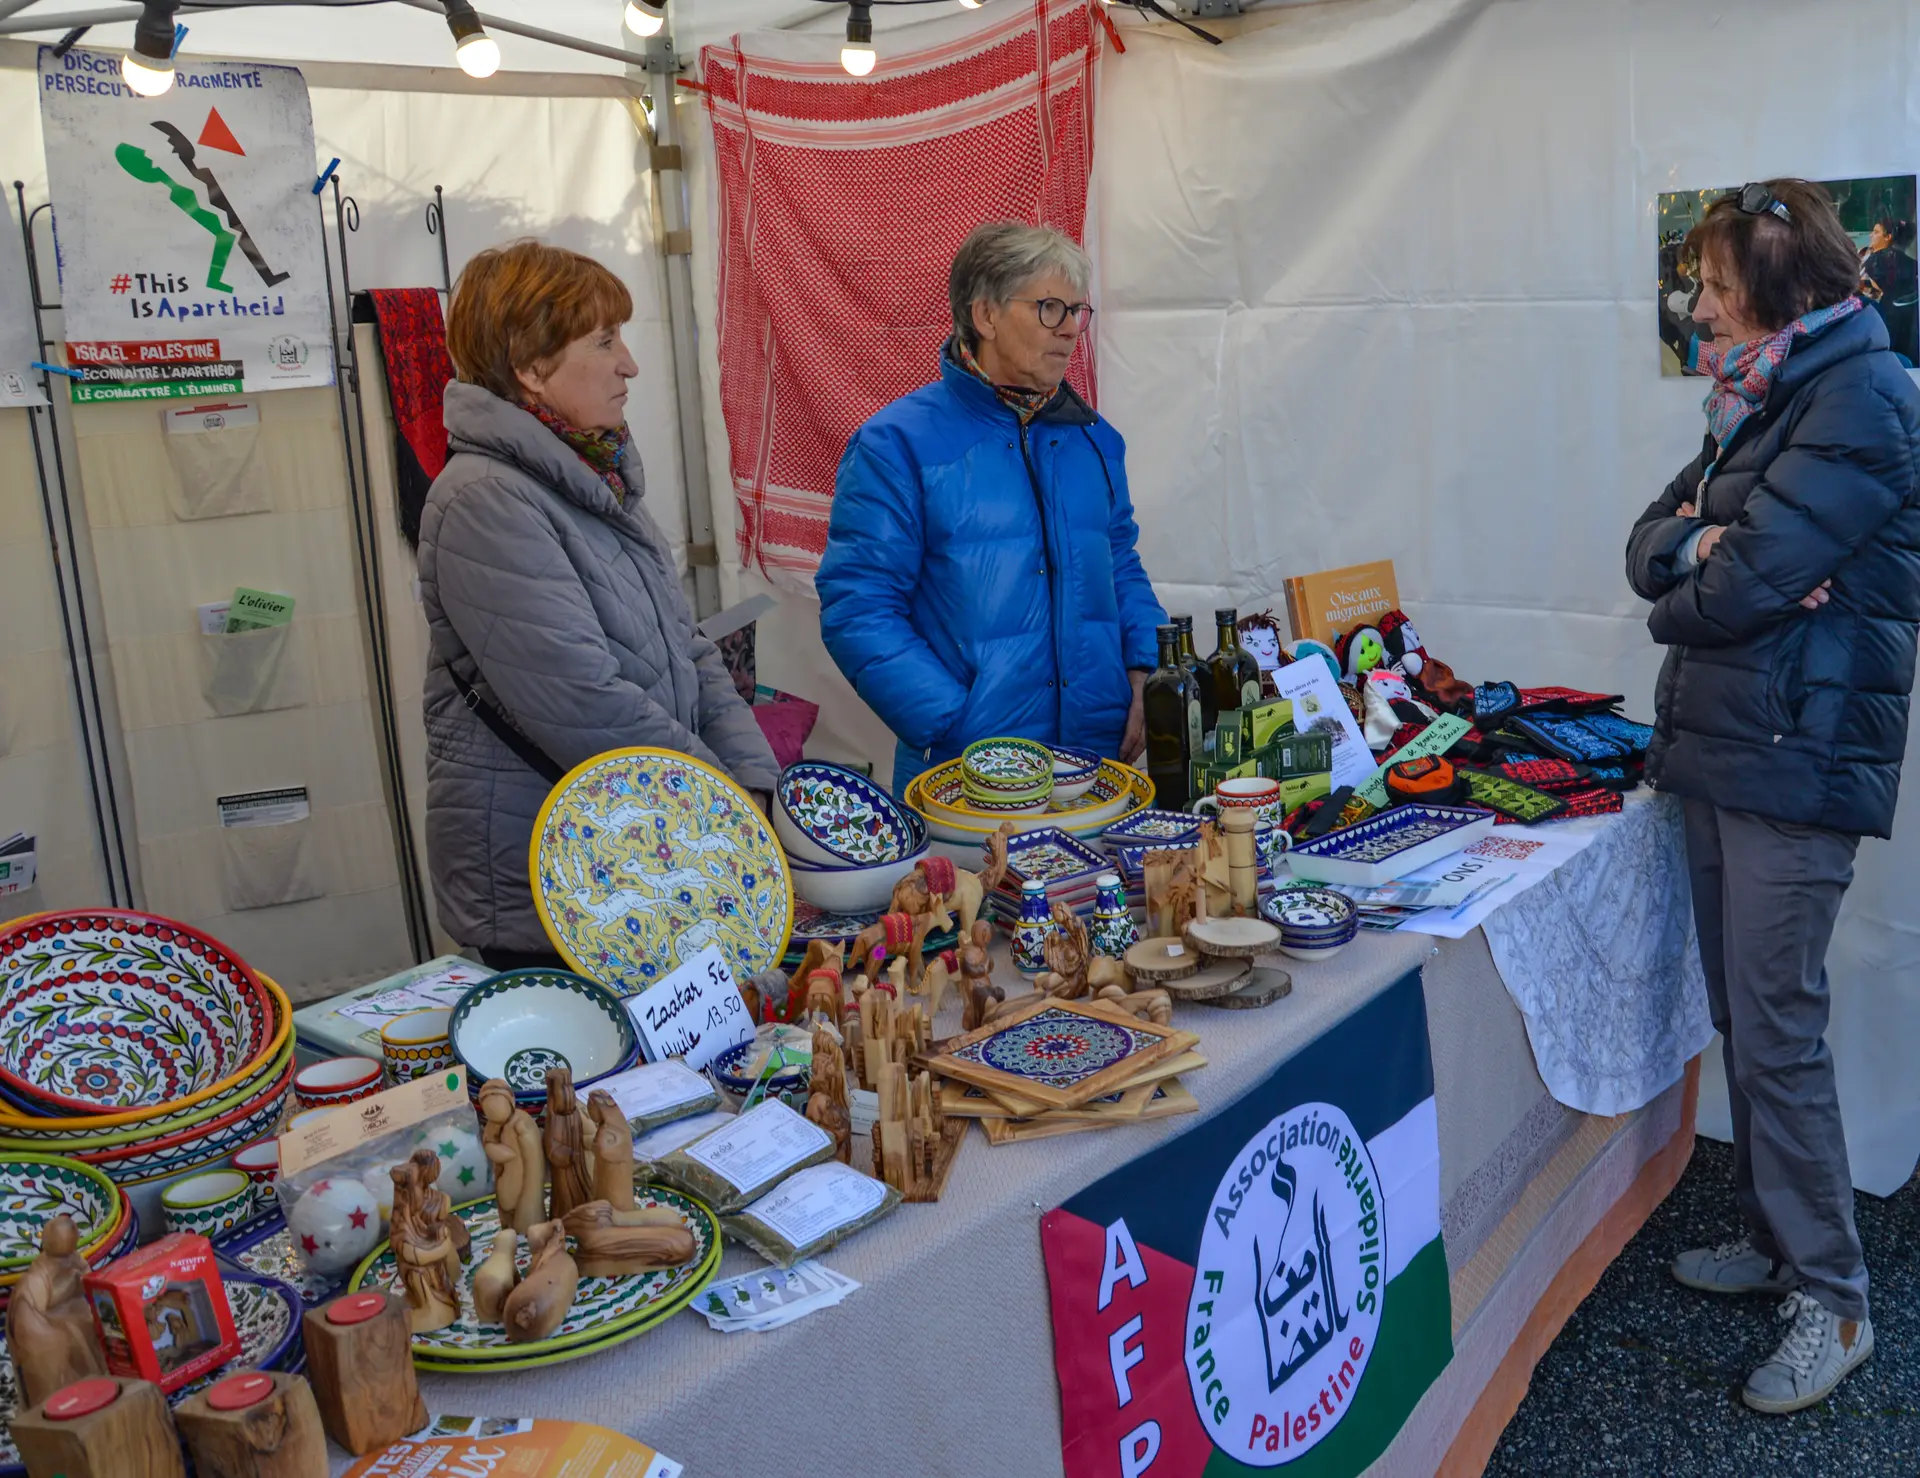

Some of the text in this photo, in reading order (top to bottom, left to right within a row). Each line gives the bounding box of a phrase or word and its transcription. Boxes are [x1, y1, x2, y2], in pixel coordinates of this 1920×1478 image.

[175, 71, 263, 89] RAGMENTE
[109, 273, 190, 295] #This
[131, 296, 285, 323] IsApartheid
[140, 342, 215, 361] PALESTINE
[162, 363, 236, 380] L'APARTHEID
[76, 381, 237, 401] LE COMBATTRE L'ÉLIMINER
[238, 594, 286, 613] L'olivier
[1330, 586, 1383, 607] Oiseaux
[1325, 598, 1391, 623] migrateurs
[1436, 862, 1484, 882] ONS
[646, 961, 730, 1032] Zaatar 5€
[706, 995, 741, 1031] 13,50
[169, 1255, 207, 1269] NATIVITY
[180, 1263, 198, 1273] SET
[1193, 1109, 1380, 1452] Association France Palestine Solidarité
[360, 1443, 414, 1478] TES
